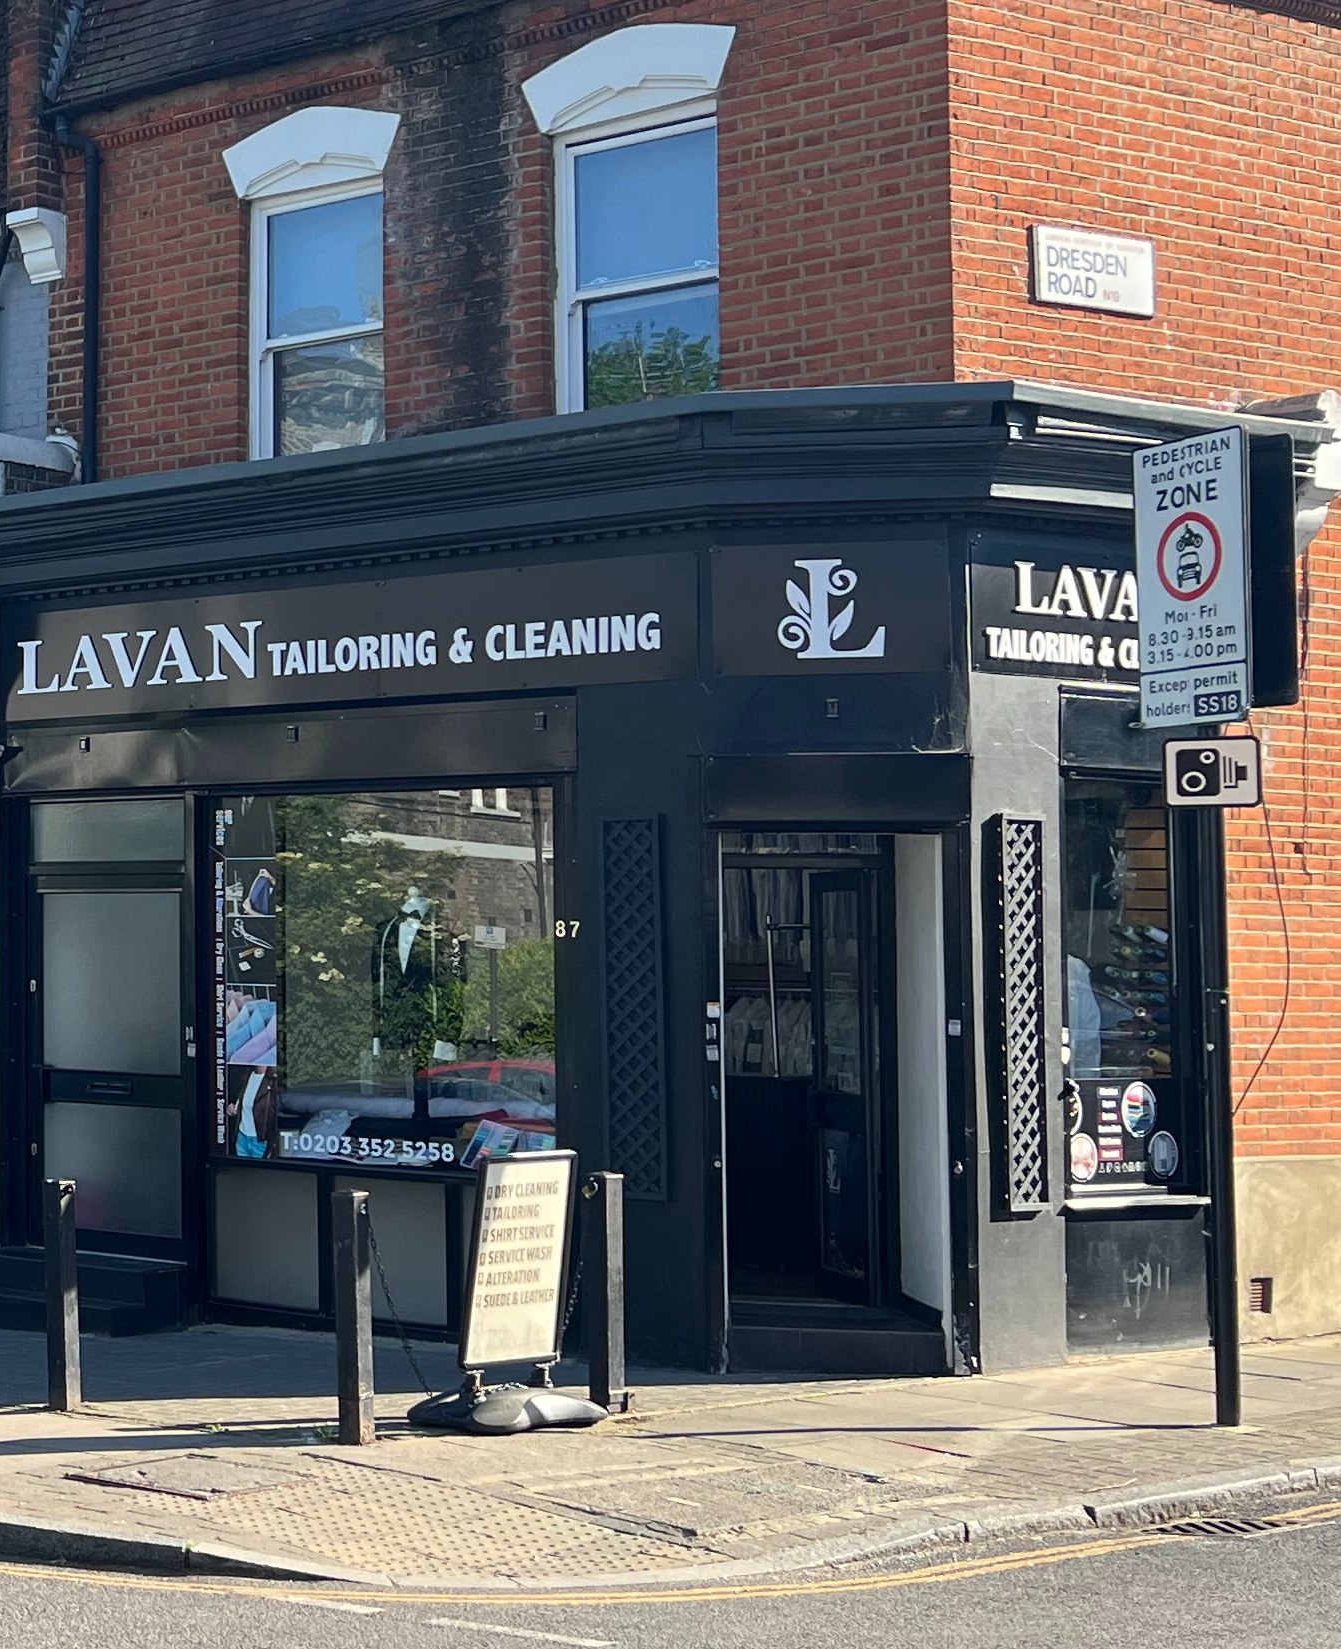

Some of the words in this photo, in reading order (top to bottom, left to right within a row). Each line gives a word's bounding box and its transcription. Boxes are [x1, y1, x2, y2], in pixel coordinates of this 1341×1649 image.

[1046, 245, 1127, 278] DRESDEN
[1047, 271, 1097, 299] ROAD
[1103, 289, 1121, 302] N19
[1142, 436, 1230, 469] PEDESTRIAN
[1151, 467, 1175, 484] and
[1179, 456, 1222, 478] CYCLE
[1156, 478, 1218, 512] ZONE
[1014, 560, 1138, 622] LAVA
[1200, 603, 1218, 619] Fri
[1148, 629, 1179, 646] 8.30
[1216, 624, 1236, 637] am
[17, 620, 264, 695] LAVAN
[267, 629, 437, 678] TAILORING
[448, 627, 474, 664] &
[485, 612, 662, 663] CLEANING
[985, 626, 1095, 666] TAILORING
[1097, 636, 1115, 668] &
[1147, 648, 1174, 664] 3.15
[1217, 643, 1237, 657] pm
[1149, 679, 1191, 694] Excep
[1194, 670, 1238, 690] permit
[1198, 694, 1238, 714] SS18
[555, 920, 580, 938] 87
[279, 1131, 352, 1155] T:0203
[358, 1137, 396, 1159] 352
[402, 1140, 455, 1163] 5258
[494, 1184, 515, 1199] DRY
[515, 1180, 559, 1198] CLEANING
[492, 1204, 540, 1221] TAILORING
[490, 1227, 518, 1243] SHIRT
[518, 1224, 555, 1240] SERVICE
[488, 1248, 525, 1265] SERVICE
[526, 1245, 553, 1261] WASH
[485, 1268, 541, 1287] ALTERATION
[483, 1292, 511, 1308] SUEDE
[511, 1291, 519, 1306] &
[520, 1288, 555, 1304] LEATHER
